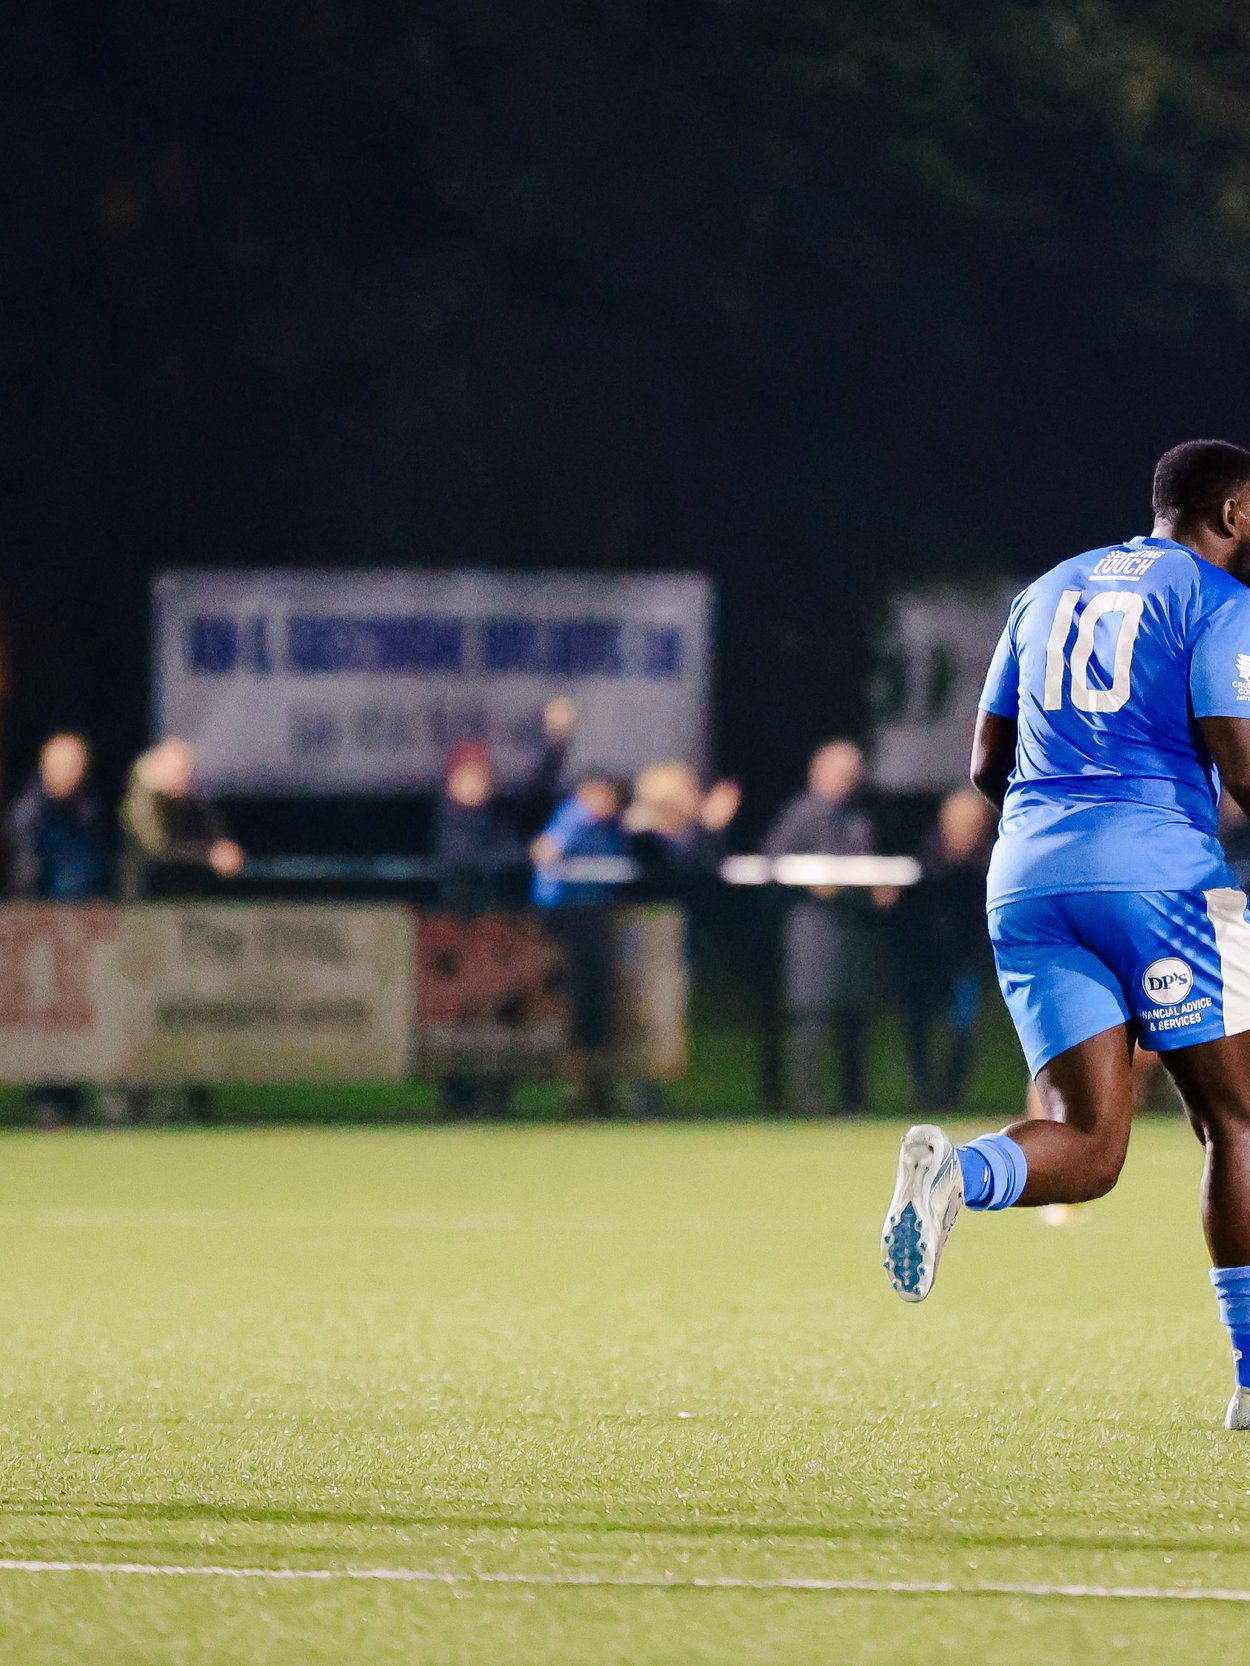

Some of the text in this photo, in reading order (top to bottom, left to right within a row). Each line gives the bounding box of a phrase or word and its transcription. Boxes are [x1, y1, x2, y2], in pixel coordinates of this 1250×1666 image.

[1094, 558, 1155, 575] TOUCH
[1043, 590, 1144, 712] 10
[1181, 997, 1212, 1013] ADVICE
[1150, 1012, 1201, 1031] & SERVICES
